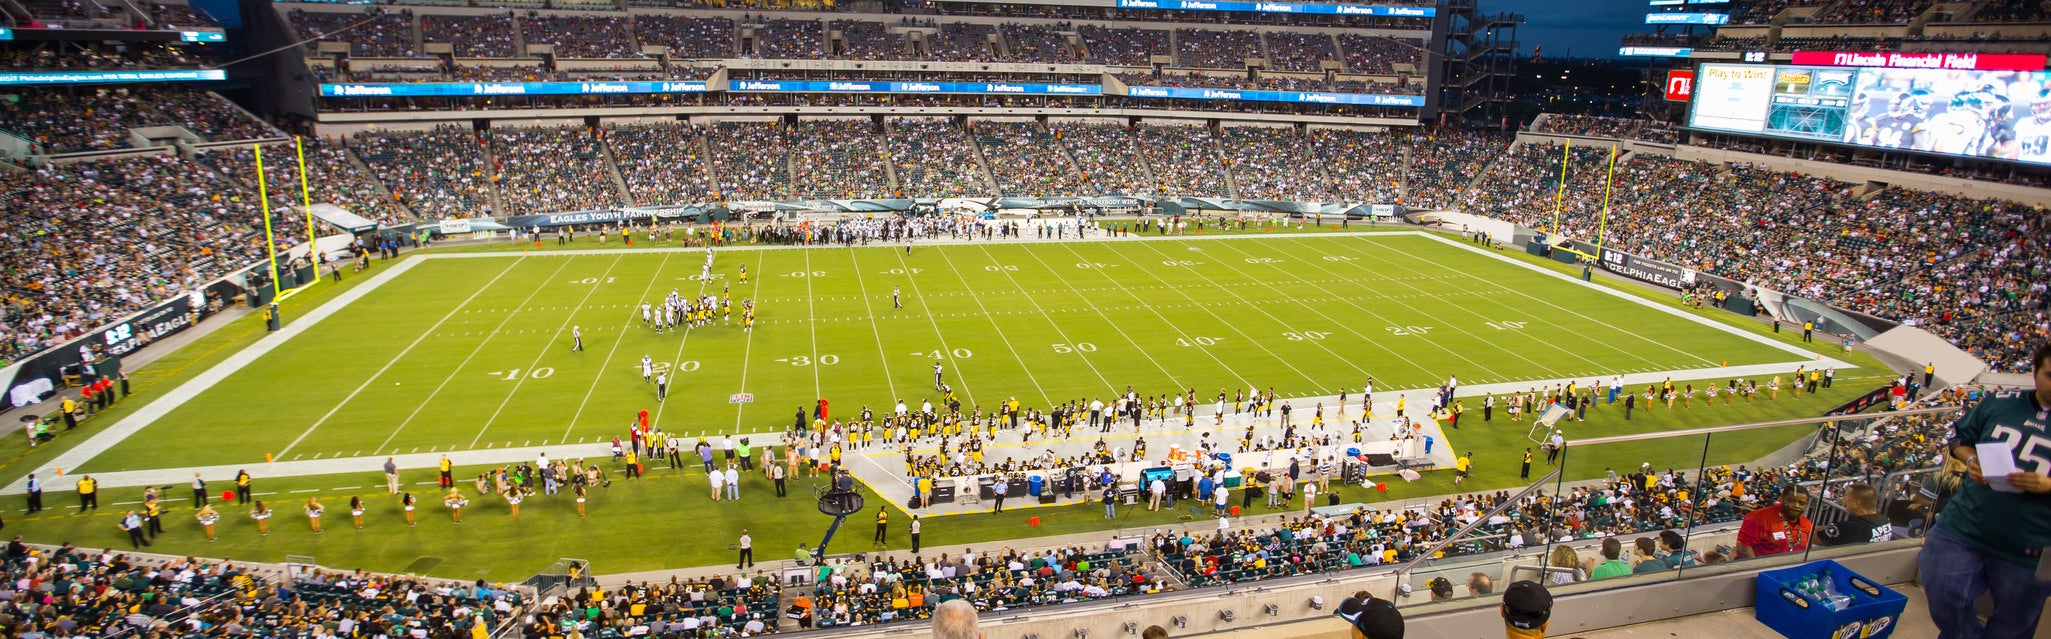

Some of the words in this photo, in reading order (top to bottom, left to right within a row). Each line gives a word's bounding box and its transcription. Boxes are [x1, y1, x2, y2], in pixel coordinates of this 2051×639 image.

[1847, 53, 1886, 66] Lincoln
[1889, 53, 1942, 68] Financial
[1944, 53, 1977, 70] Field
[1709, 69, 1727, 80] Play
[1731, 70, 1741, 79] to
[1779, 73, 1811, 84] Steelers
[344, 84, 392, 95] Jefferson
[484, 83, 525, 94] Jefferson
[747, 81, 780, 91] Jefferson
[908, 82, 940, 91] Jefferson
[550, 213, 588, 224] EAGLES
[590, 210, 621, 221] YOUTH
[1282, 330, 1326, 342] 30
[1385, 325, 1428, 336] 20
[1051, 342, 1098, 354] 50
[1175, 336, 1217, 348] 40
[927, 348, 973, 360] 40
[791, 354, 840, 367] 30
[501, 366, 555, 381] 10
[1872, 523, 1893, 538] APEX
